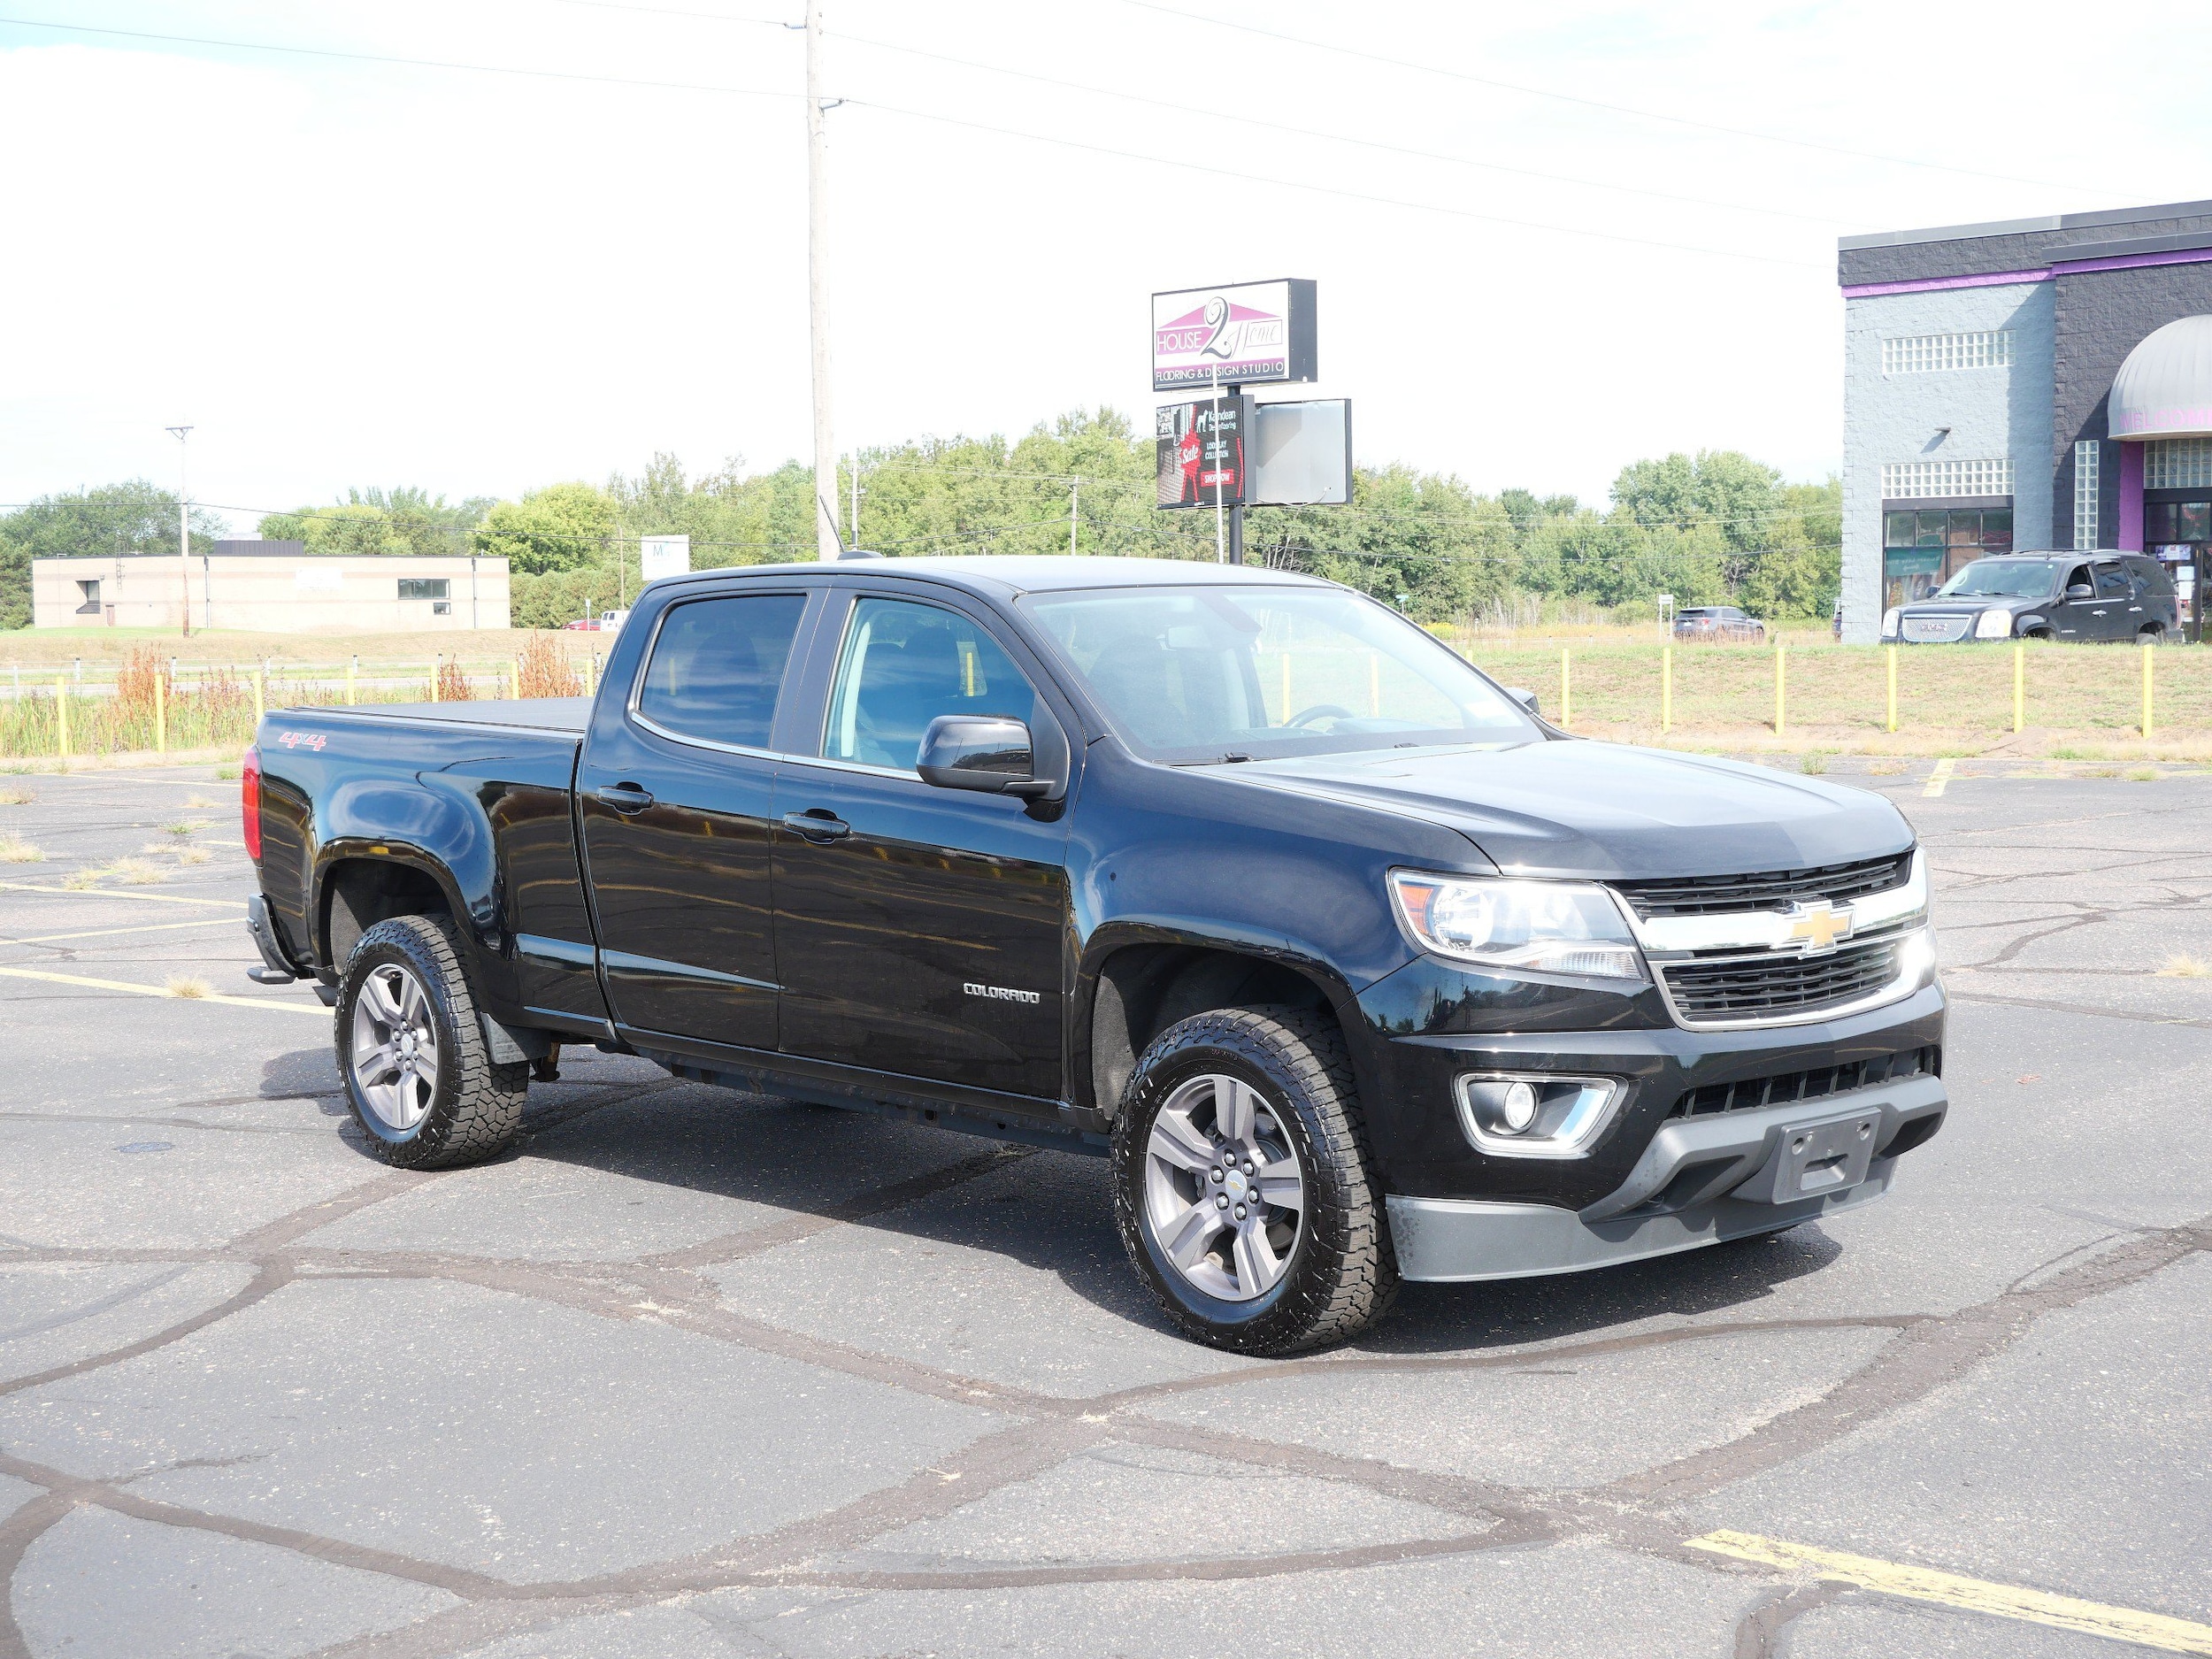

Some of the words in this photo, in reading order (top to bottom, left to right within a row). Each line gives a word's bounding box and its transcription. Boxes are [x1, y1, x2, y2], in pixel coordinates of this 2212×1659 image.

[1156, 331, 1202, 352] HOUSE
[1200, 296, 1233, 360] 2
[1156, 368, 1195, 381] FLOORING
[1197, 369, 1204, 378] &
[1205, 365, 1240, 378] DSIGN
[1241, 361, 1284, 375] STUDIO
[1209, 409, 1236, 423] Kandean
[1182, 444, 1199, 465] Sale
[963, 982, 1041, 1004] COLORADO
